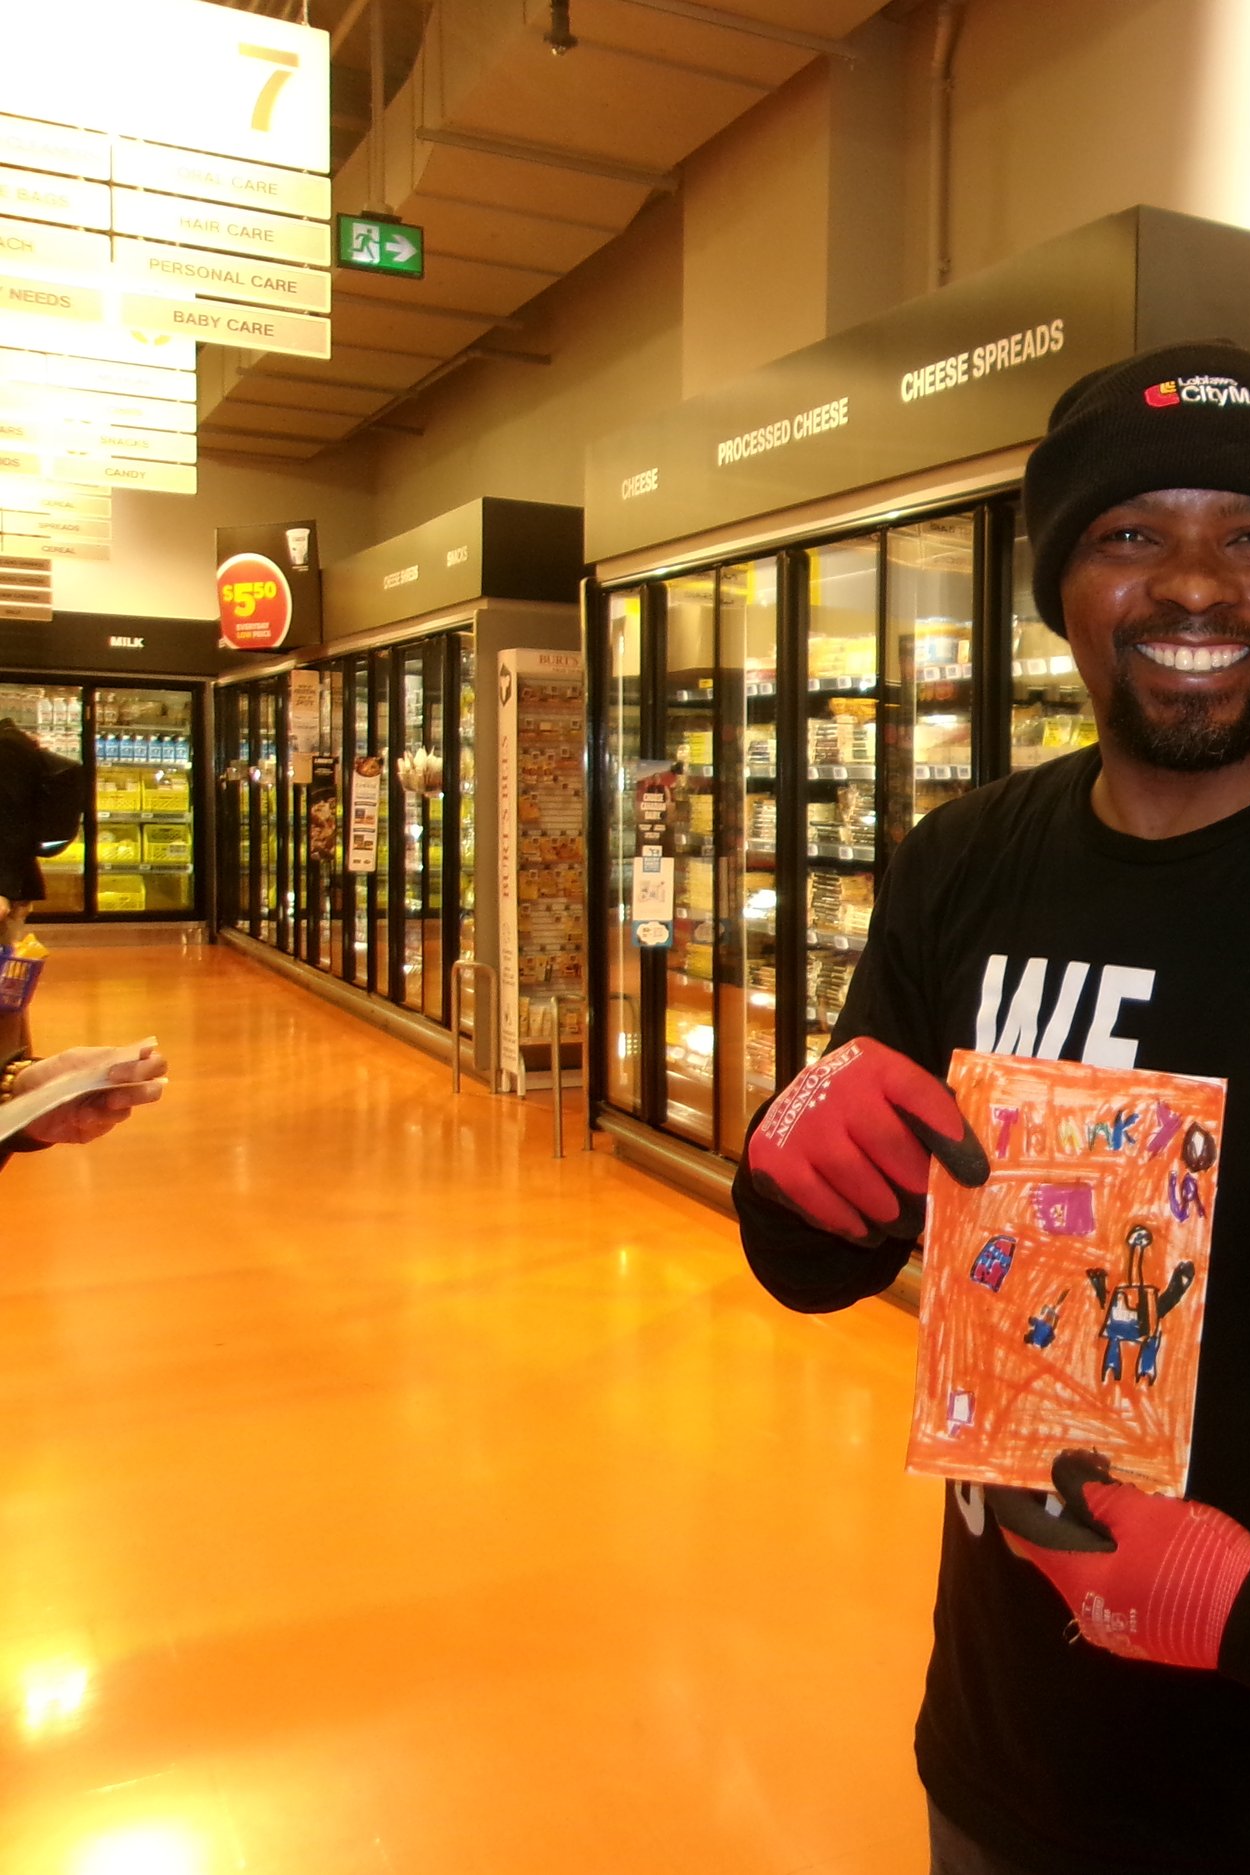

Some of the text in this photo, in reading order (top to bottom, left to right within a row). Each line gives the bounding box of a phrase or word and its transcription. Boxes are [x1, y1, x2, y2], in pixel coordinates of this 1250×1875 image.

[239, 42, 299, 132] 7
[231, 176, 279, 196] CARE
[180, 216, 274, 243] HAIR CARE
[149, 257, 298, 295] PERSONAL CARE
[9, 287, 71, 309] NEEDS
[172, 309, 274, 338] BABY CARE
[901, 318, 1065, 404] CHEESE SPREADS
[718, 397, 849, 467] PROCESSED CHEESE
[104, 467, 146, 479] CANDY
[622, 467, 658, 500] CHEESE
[110, 635, 144, 648] MILK
[975, 954, 1156, 1069] WE
